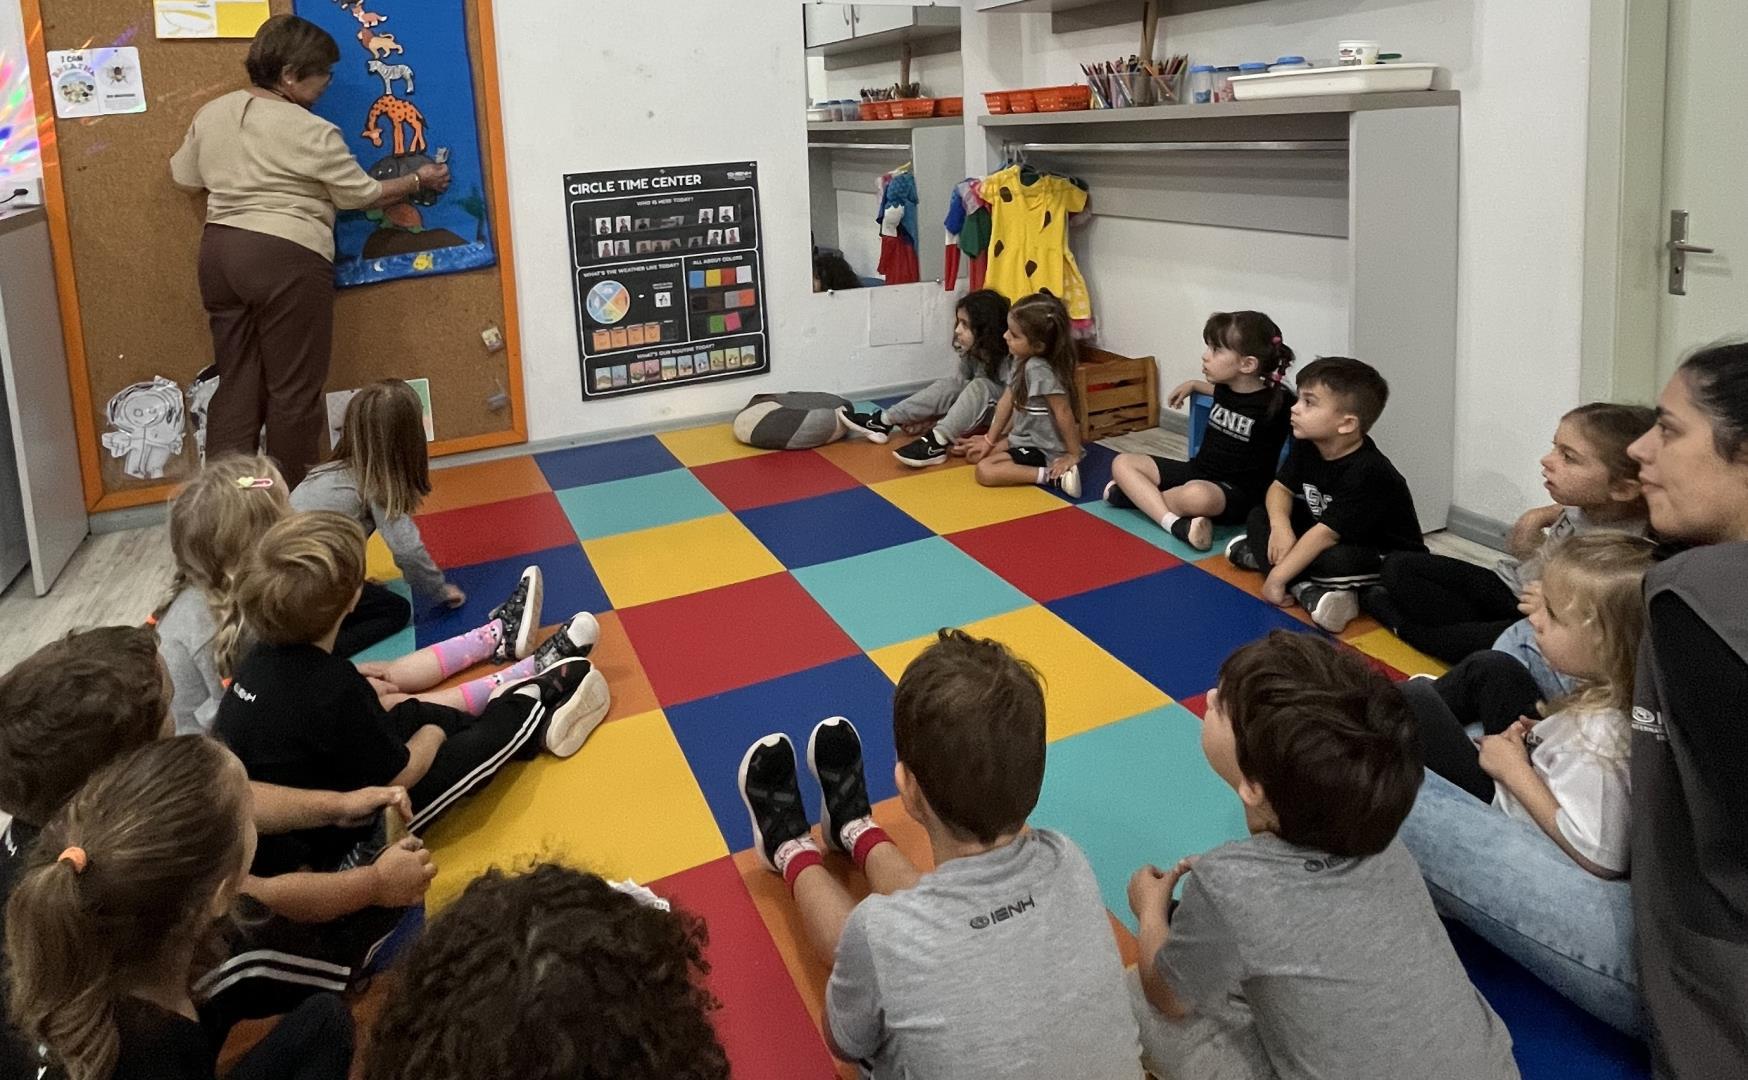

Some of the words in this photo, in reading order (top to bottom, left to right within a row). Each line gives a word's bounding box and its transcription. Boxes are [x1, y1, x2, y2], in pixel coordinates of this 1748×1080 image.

[67, 55, 83, 63] CAN
[569, 180, 615, 196] CIRCLE
[618, 177, 649, 192] TIME
[651, 174, 702, 188] CENTER
[583, 270, 605, 278] WHAT'S
[618, 266, 645, 274] WEATHER
[658, 262, 680, 270] TODAY?
[695, 343, 715, 351] TODAY?
[990, 895, 1035, 925] IENH
